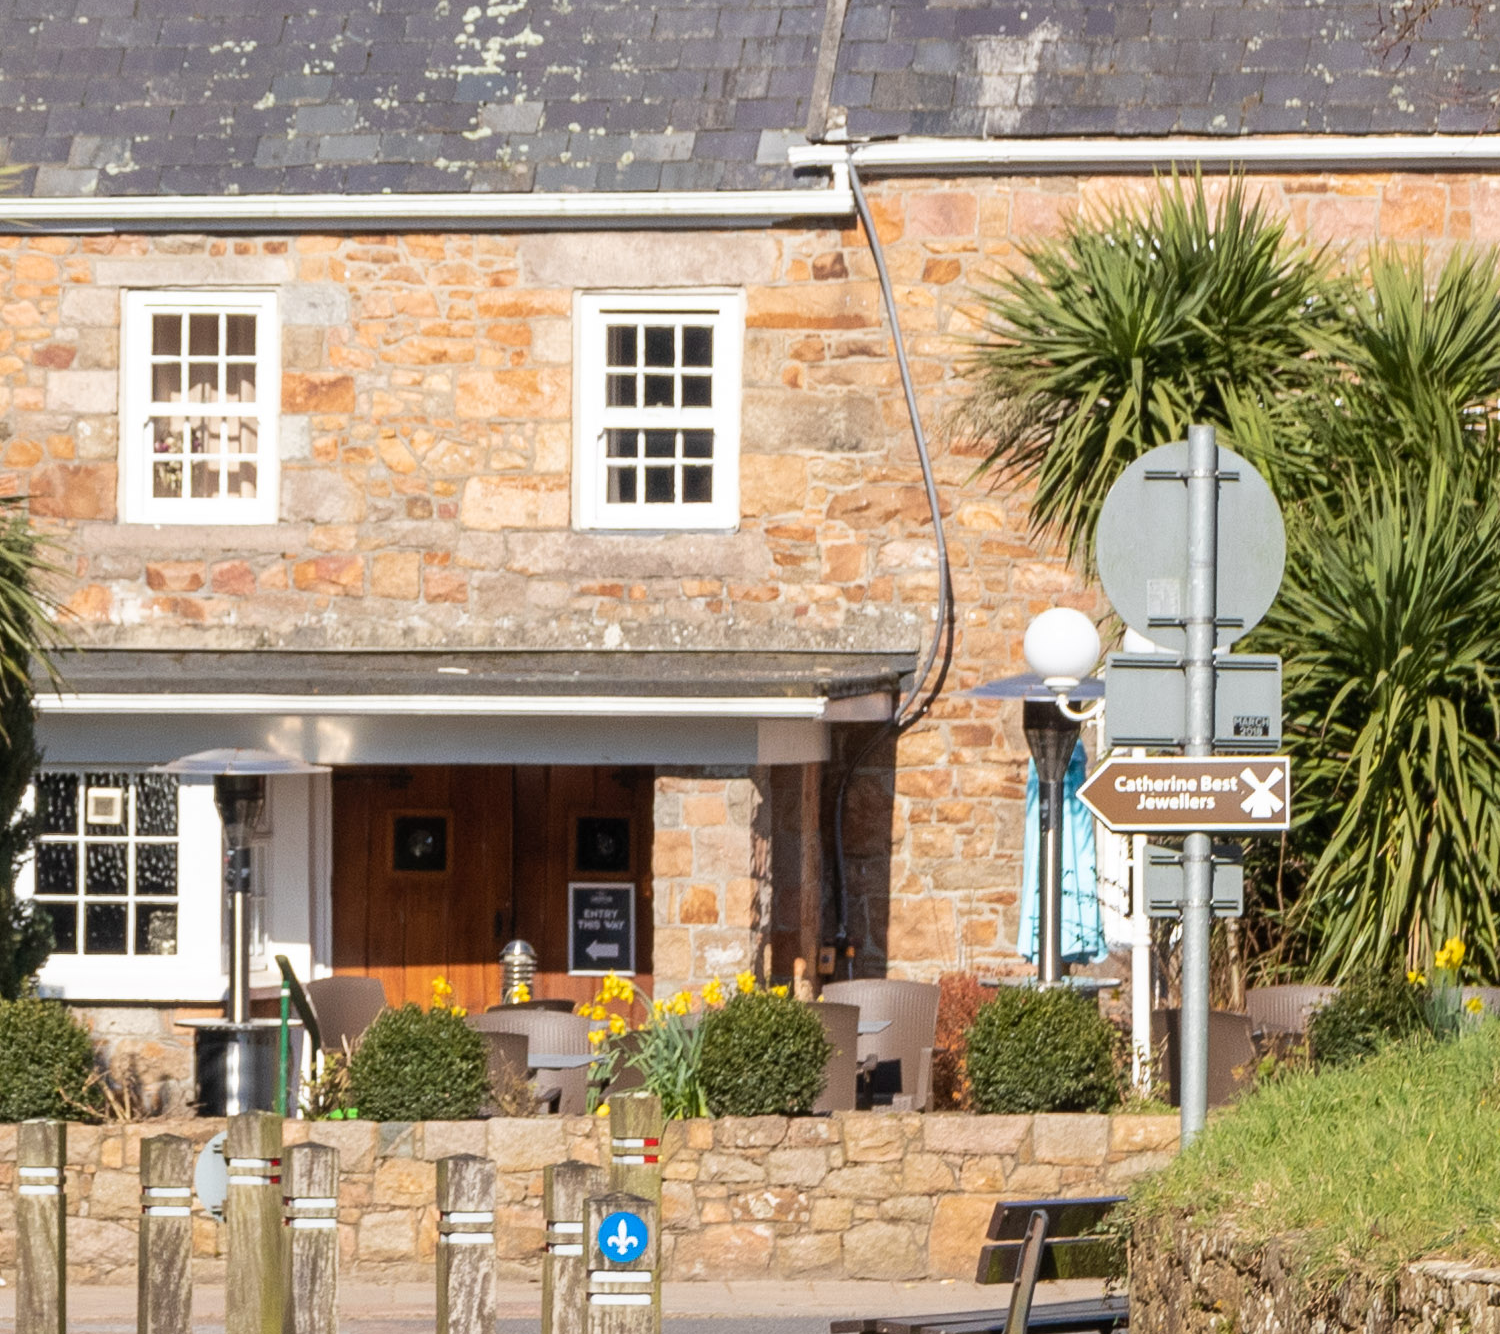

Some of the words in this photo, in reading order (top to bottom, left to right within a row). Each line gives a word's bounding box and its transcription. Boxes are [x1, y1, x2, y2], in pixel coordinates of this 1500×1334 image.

[1232, 716, 1270, 727] MARCH
[1240, 726, 1263, 737] 2018
[1114, 774, 1198, 793] Catherine
[1200, 774, 1238, 792] Best
[1136, 792, 1216, 811] Jewellers
[583, 908, 619, 919] ENTRY
[577, 919, 601, 930] THIS
[603, 920, 626, 930] WAY
